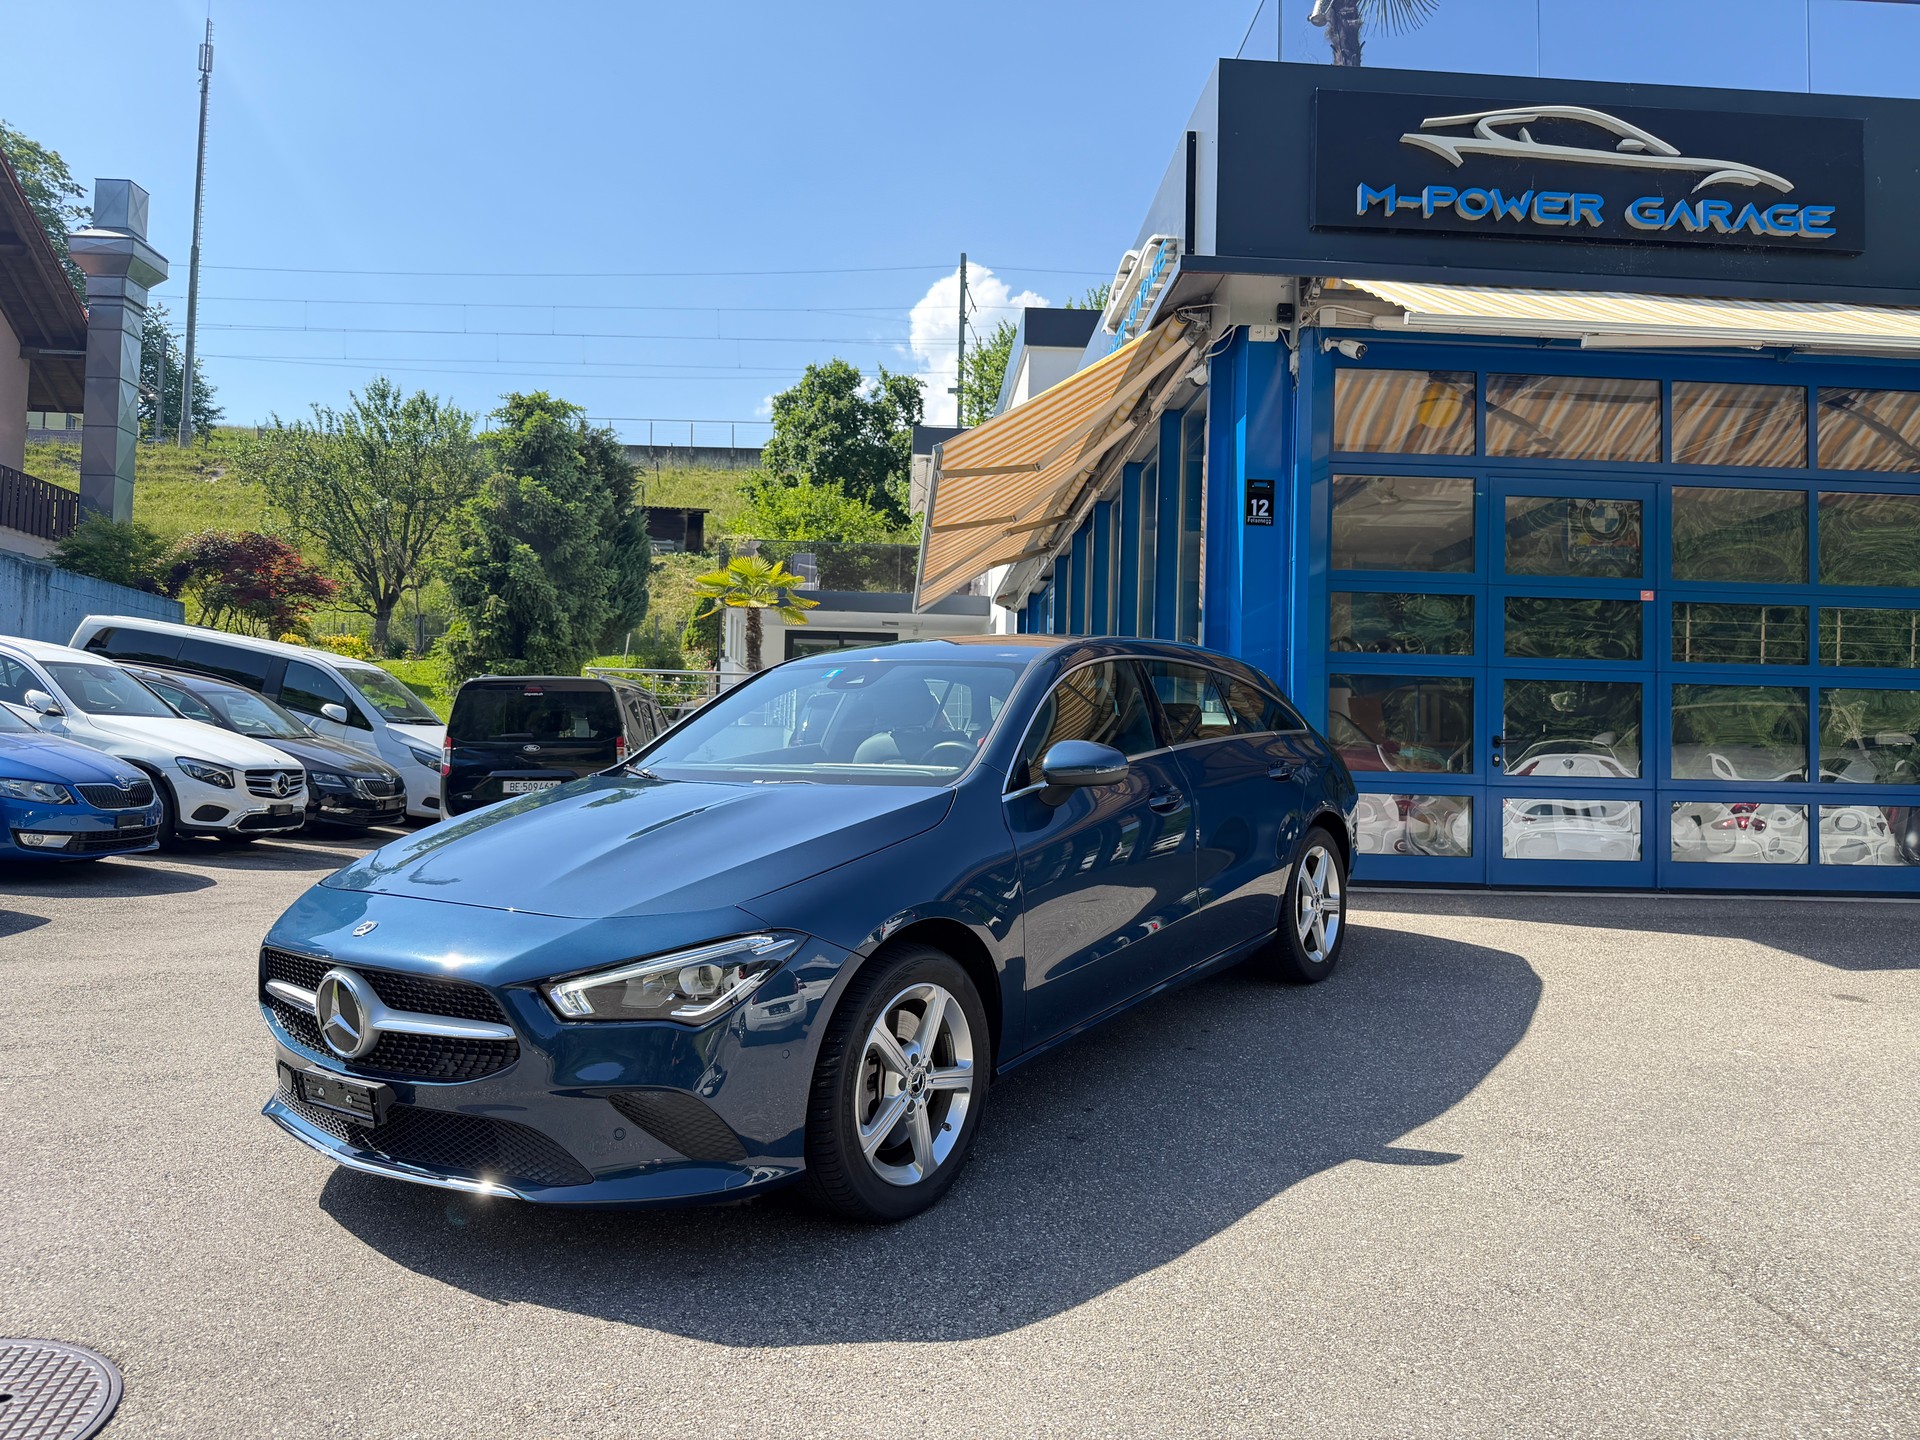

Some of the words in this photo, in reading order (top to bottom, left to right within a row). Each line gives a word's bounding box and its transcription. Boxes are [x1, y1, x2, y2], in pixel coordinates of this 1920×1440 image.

[1357, 182, 1604, 227] M-POWER
[1624, 196, 1837, 238] GARAGE
[1250, 498, 1269, 516] 12
